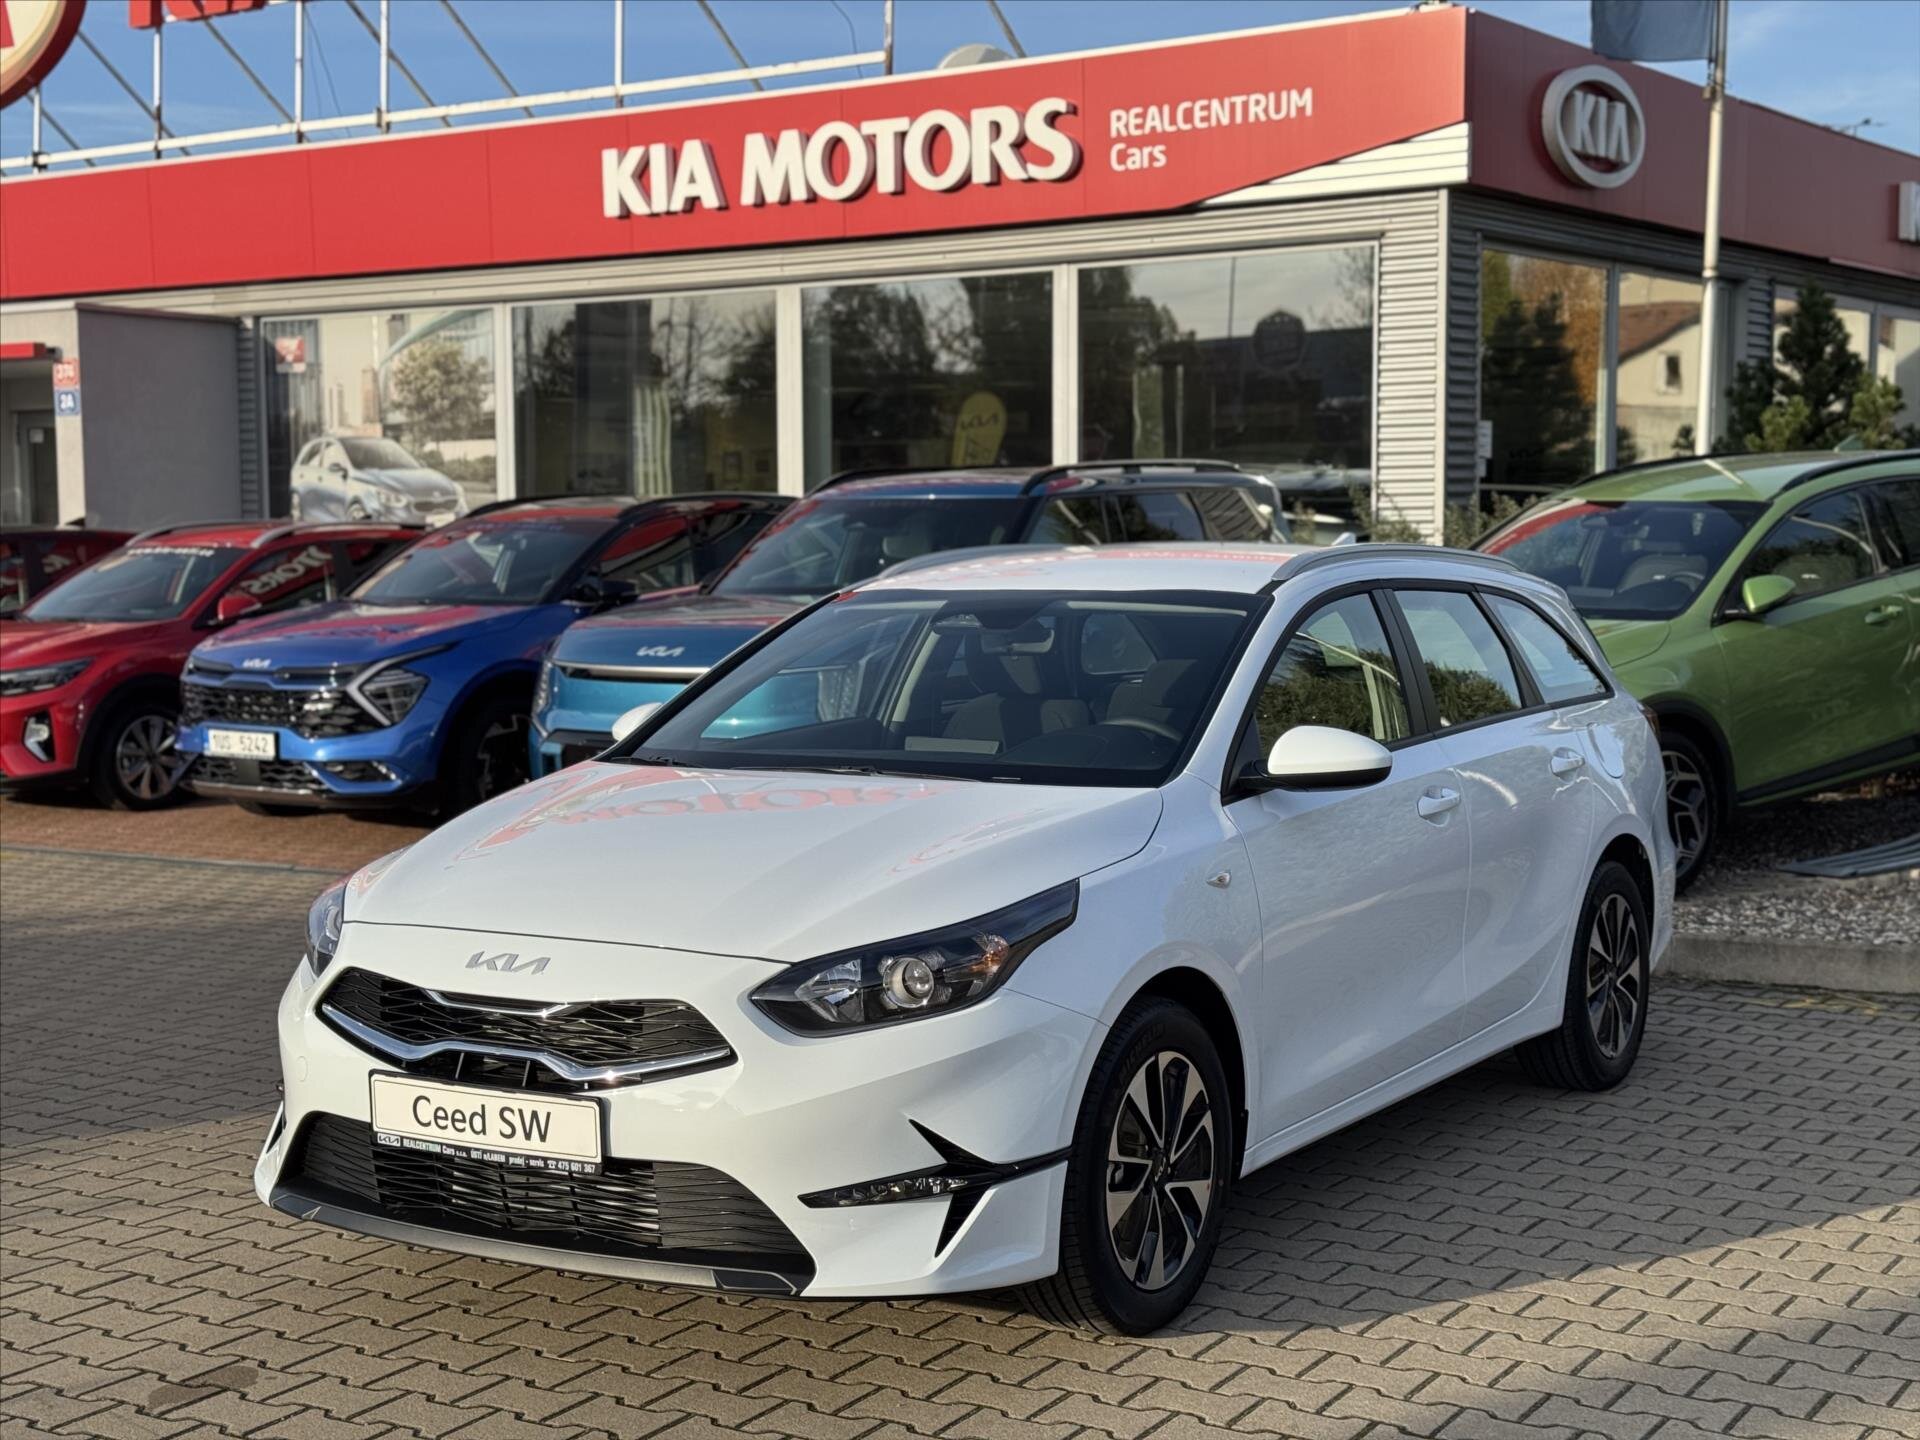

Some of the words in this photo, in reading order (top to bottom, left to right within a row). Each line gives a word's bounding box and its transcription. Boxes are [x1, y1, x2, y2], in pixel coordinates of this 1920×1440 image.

[1109, 87, 1313, 138] REALCENTRUM
[1570, 90, 1631, 163] KIA
[601, 140, 727, 218] KIA
[740, 97, 1083, 207] MOTORS
[1109, 142, 1167, 172] Cars
[635, 646, 686, 658] KIA
[239, 735, 269, 753] 5242
[465, 950, 551, 975] KIA
[412, 1094, 487, 1136] Ceed
[498, 1106, 551, 1143] SW
[378, 1135, 400, 1145] KIA
[402, 1137, 442, 1154] REALCENTRUM
[442, 1145, 456, 1157] Cars
[557, 1160, 570, 1171] 475
[570, 1163, 583, 1173] 601
[583, 1164, 596, 1174] 367
